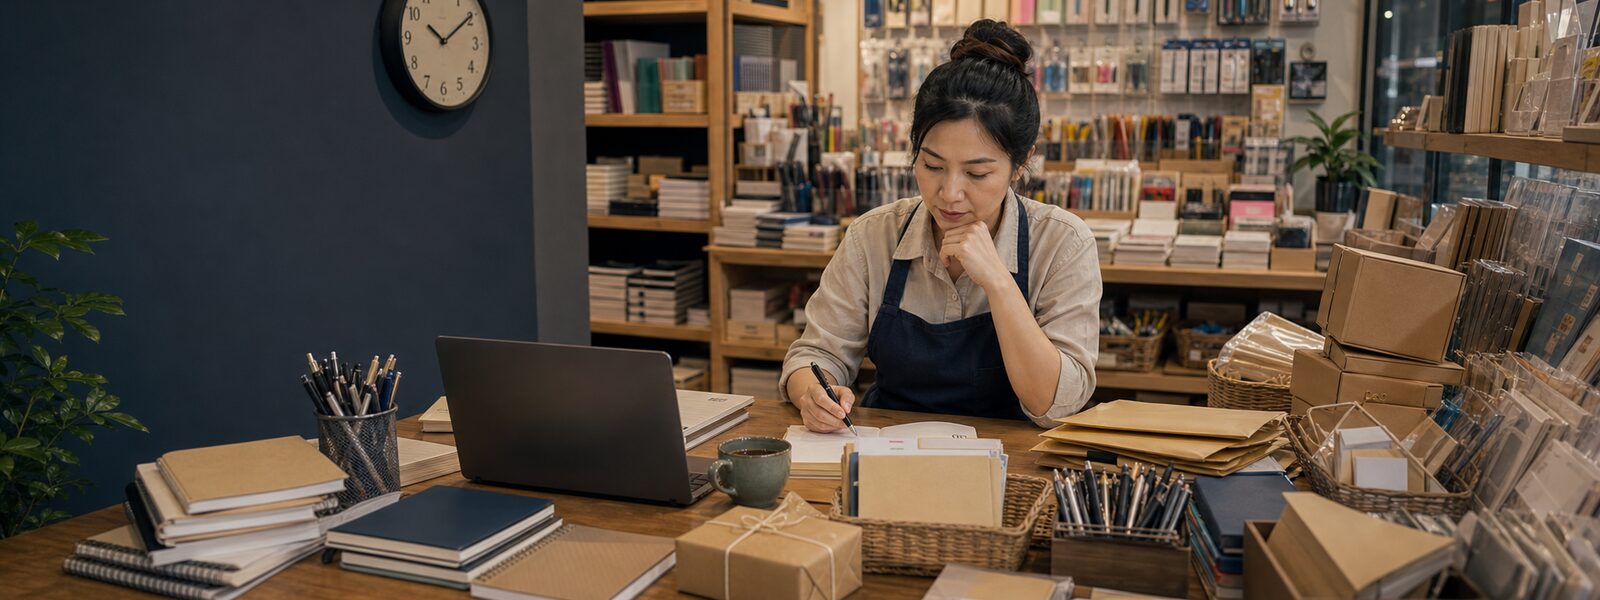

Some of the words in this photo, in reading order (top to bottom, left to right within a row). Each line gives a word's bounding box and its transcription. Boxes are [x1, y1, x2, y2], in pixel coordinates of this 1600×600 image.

[409, 6, 420, 21] 10
[467, 11, 473, 26] 2
[404, 30, 412, 45] 9
[472, 36, 478, 50] 3
[411, 56, 418, 70] 8
[468, 60, 474, 74] 4
[424, 75, 430, 89] 7
[440, 82, 447, 96] 6
[456, 78, 463, 91] 5
